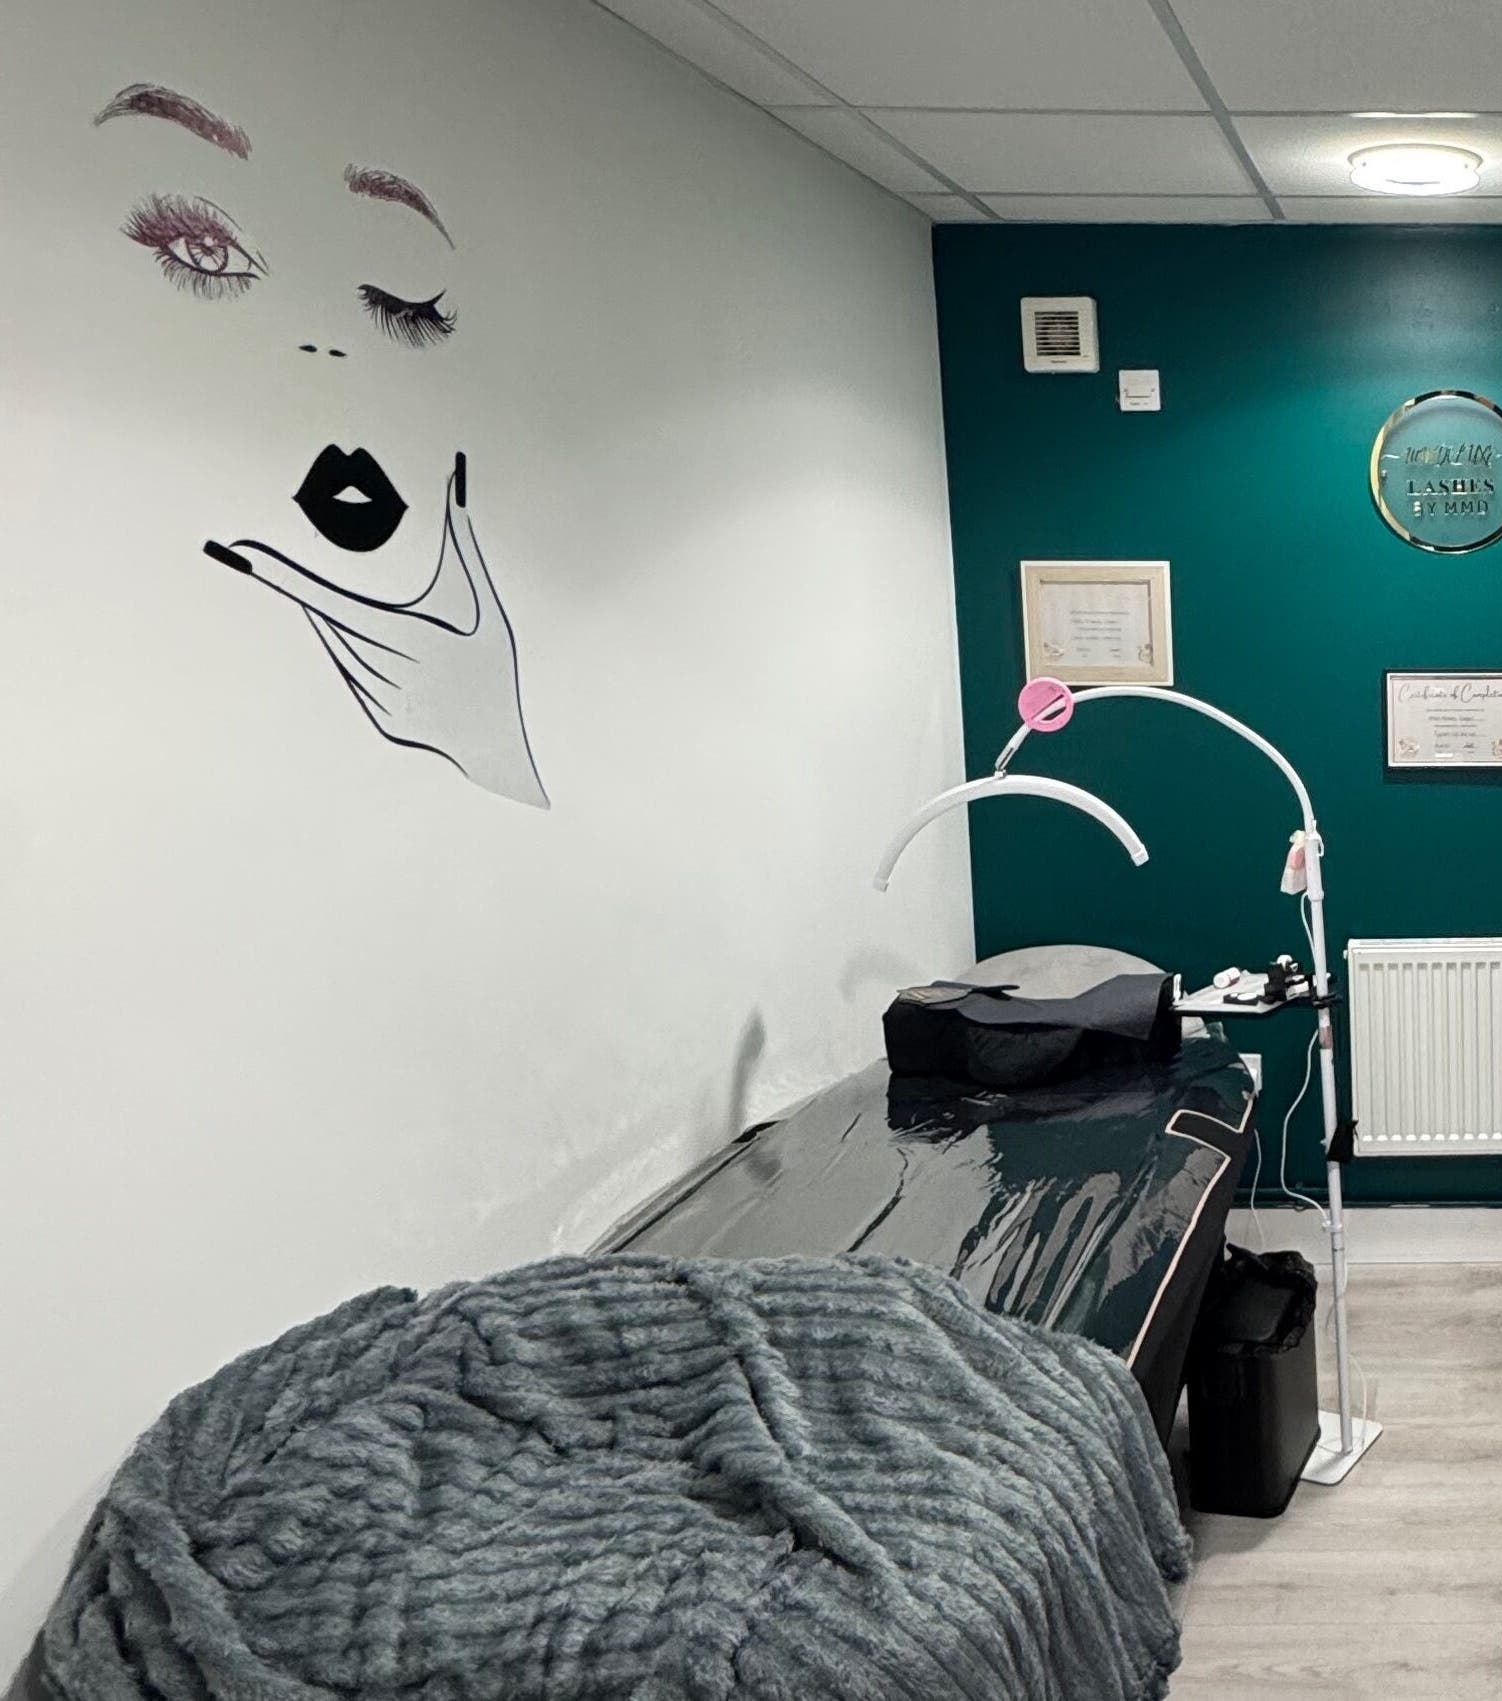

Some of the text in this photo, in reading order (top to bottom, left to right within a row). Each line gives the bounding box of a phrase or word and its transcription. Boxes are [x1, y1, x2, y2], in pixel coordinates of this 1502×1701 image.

[1407, 479, 1495, 495] LASHES
[1413, 501, 1489, 516] BY MMD
[1398, 683, 1447, 703] Certificate
